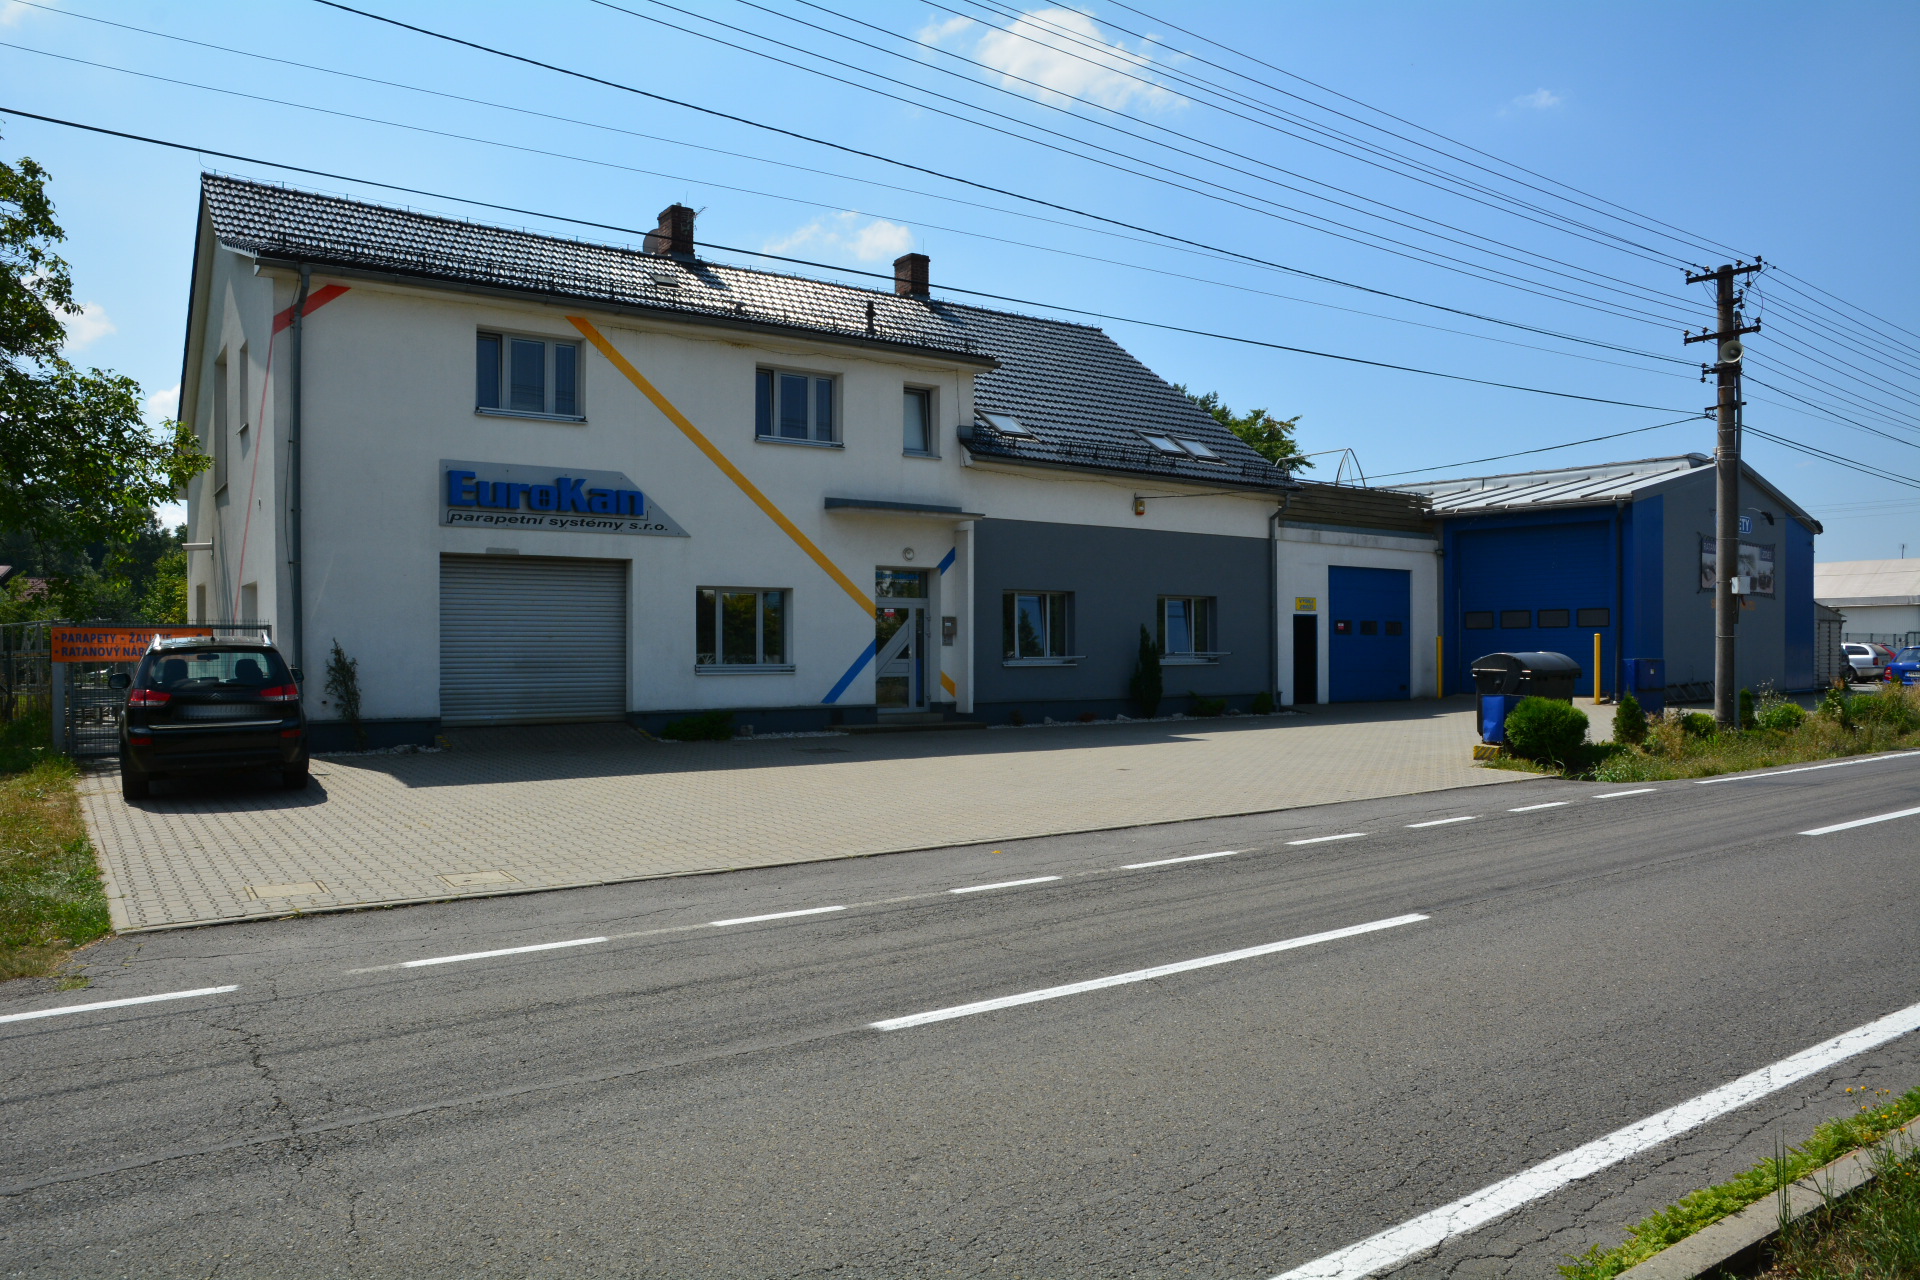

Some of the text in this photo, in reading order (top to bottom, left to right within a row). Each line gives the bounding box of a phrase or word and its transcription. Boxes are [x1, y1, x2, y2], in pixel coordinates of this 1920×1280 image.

[446, 470, 644, 516] EuroKan
[449, 512, 668, 531] parapetní systémy s.r.o.
[61, 633, 117, 643] PARAPETY
[61, 645, 142, 656] RATANOVÝ NÁB
